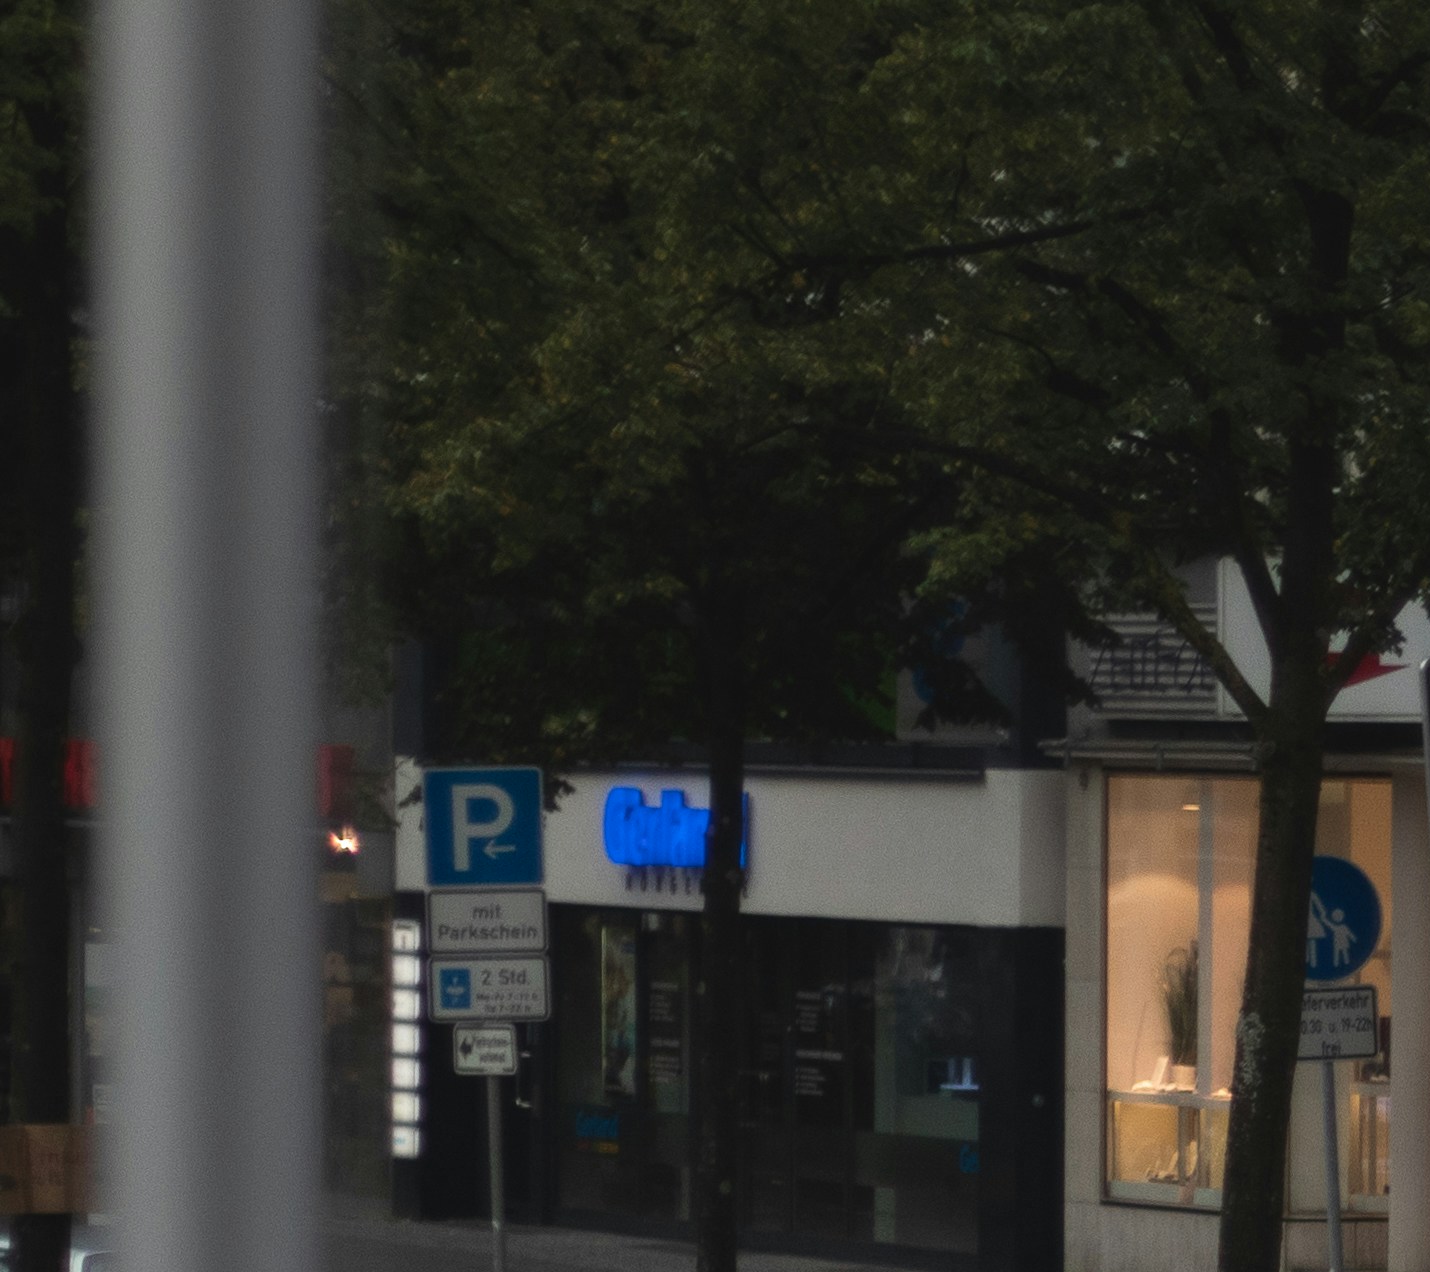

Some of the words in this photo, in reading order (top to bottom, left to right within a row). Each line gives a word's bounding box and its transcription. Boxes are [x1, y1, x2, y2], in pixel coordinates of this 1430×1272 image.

[451, 782, 517, 873] P
[473, 904, 501, 920] mit
[438, 924, 538, 941] Parkschein
[481, 969, 492, 986] 2
[498, 968, 530, 986] Std.
